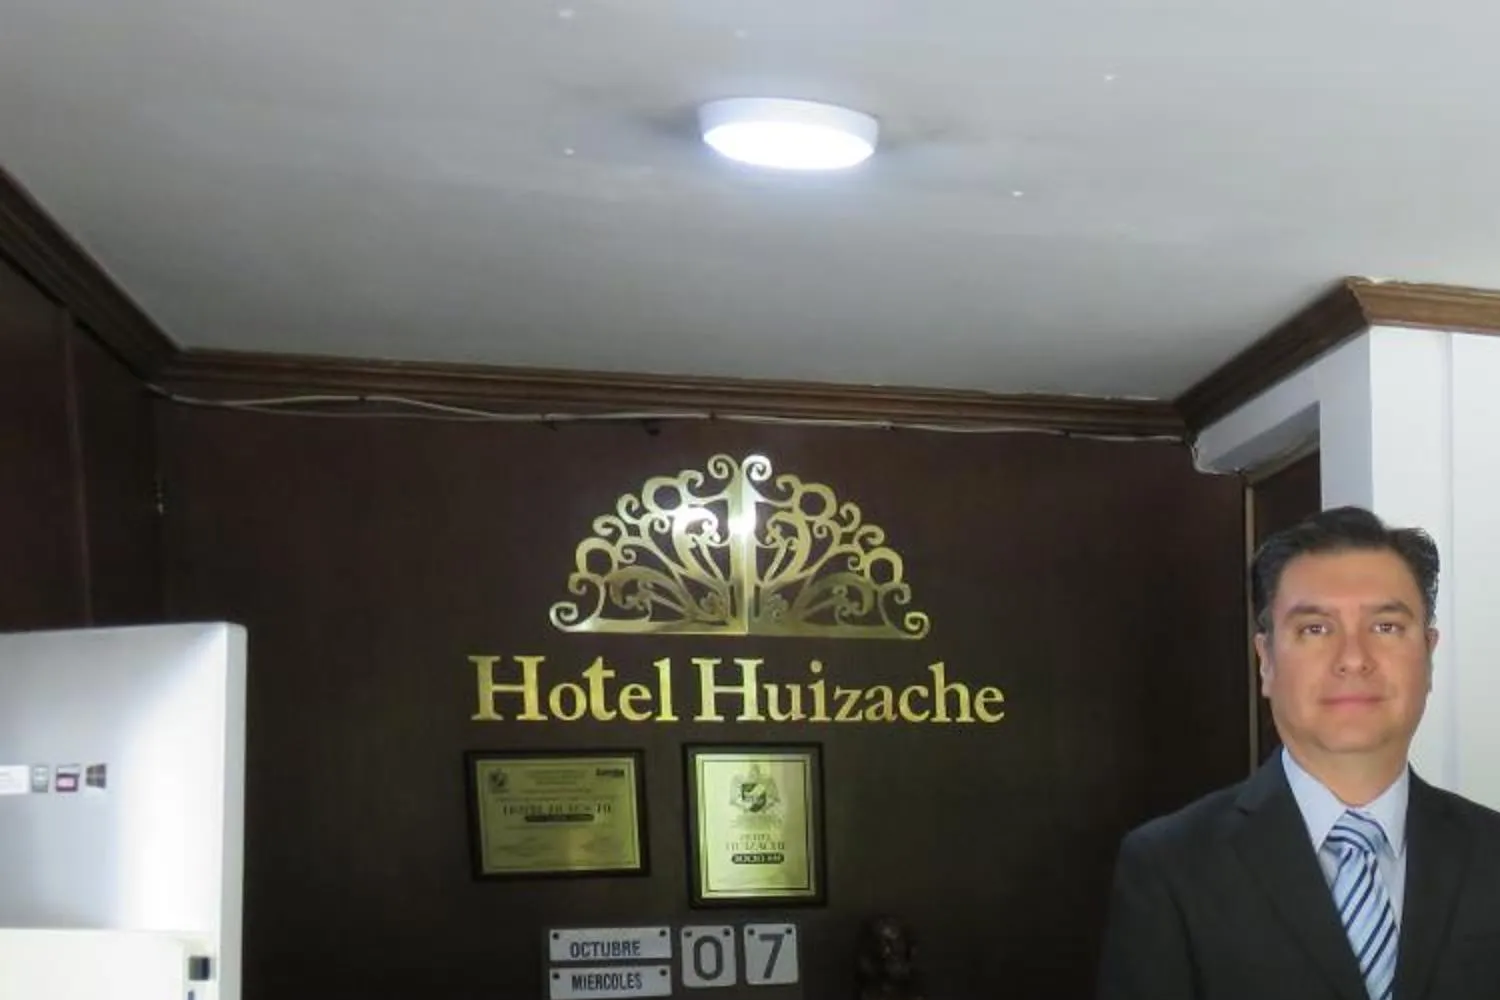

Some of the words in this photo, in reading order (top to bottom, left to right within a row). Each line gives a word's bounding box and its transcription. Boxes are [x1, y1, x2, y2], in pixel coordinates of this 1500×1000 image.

[467, 655, 678, 722] Hotel
[691, 656, 1006, 724] Huizache
[570, 940, 641, 959] OCTUBRE
[571, 971, 643, 993] MIERCOLES
